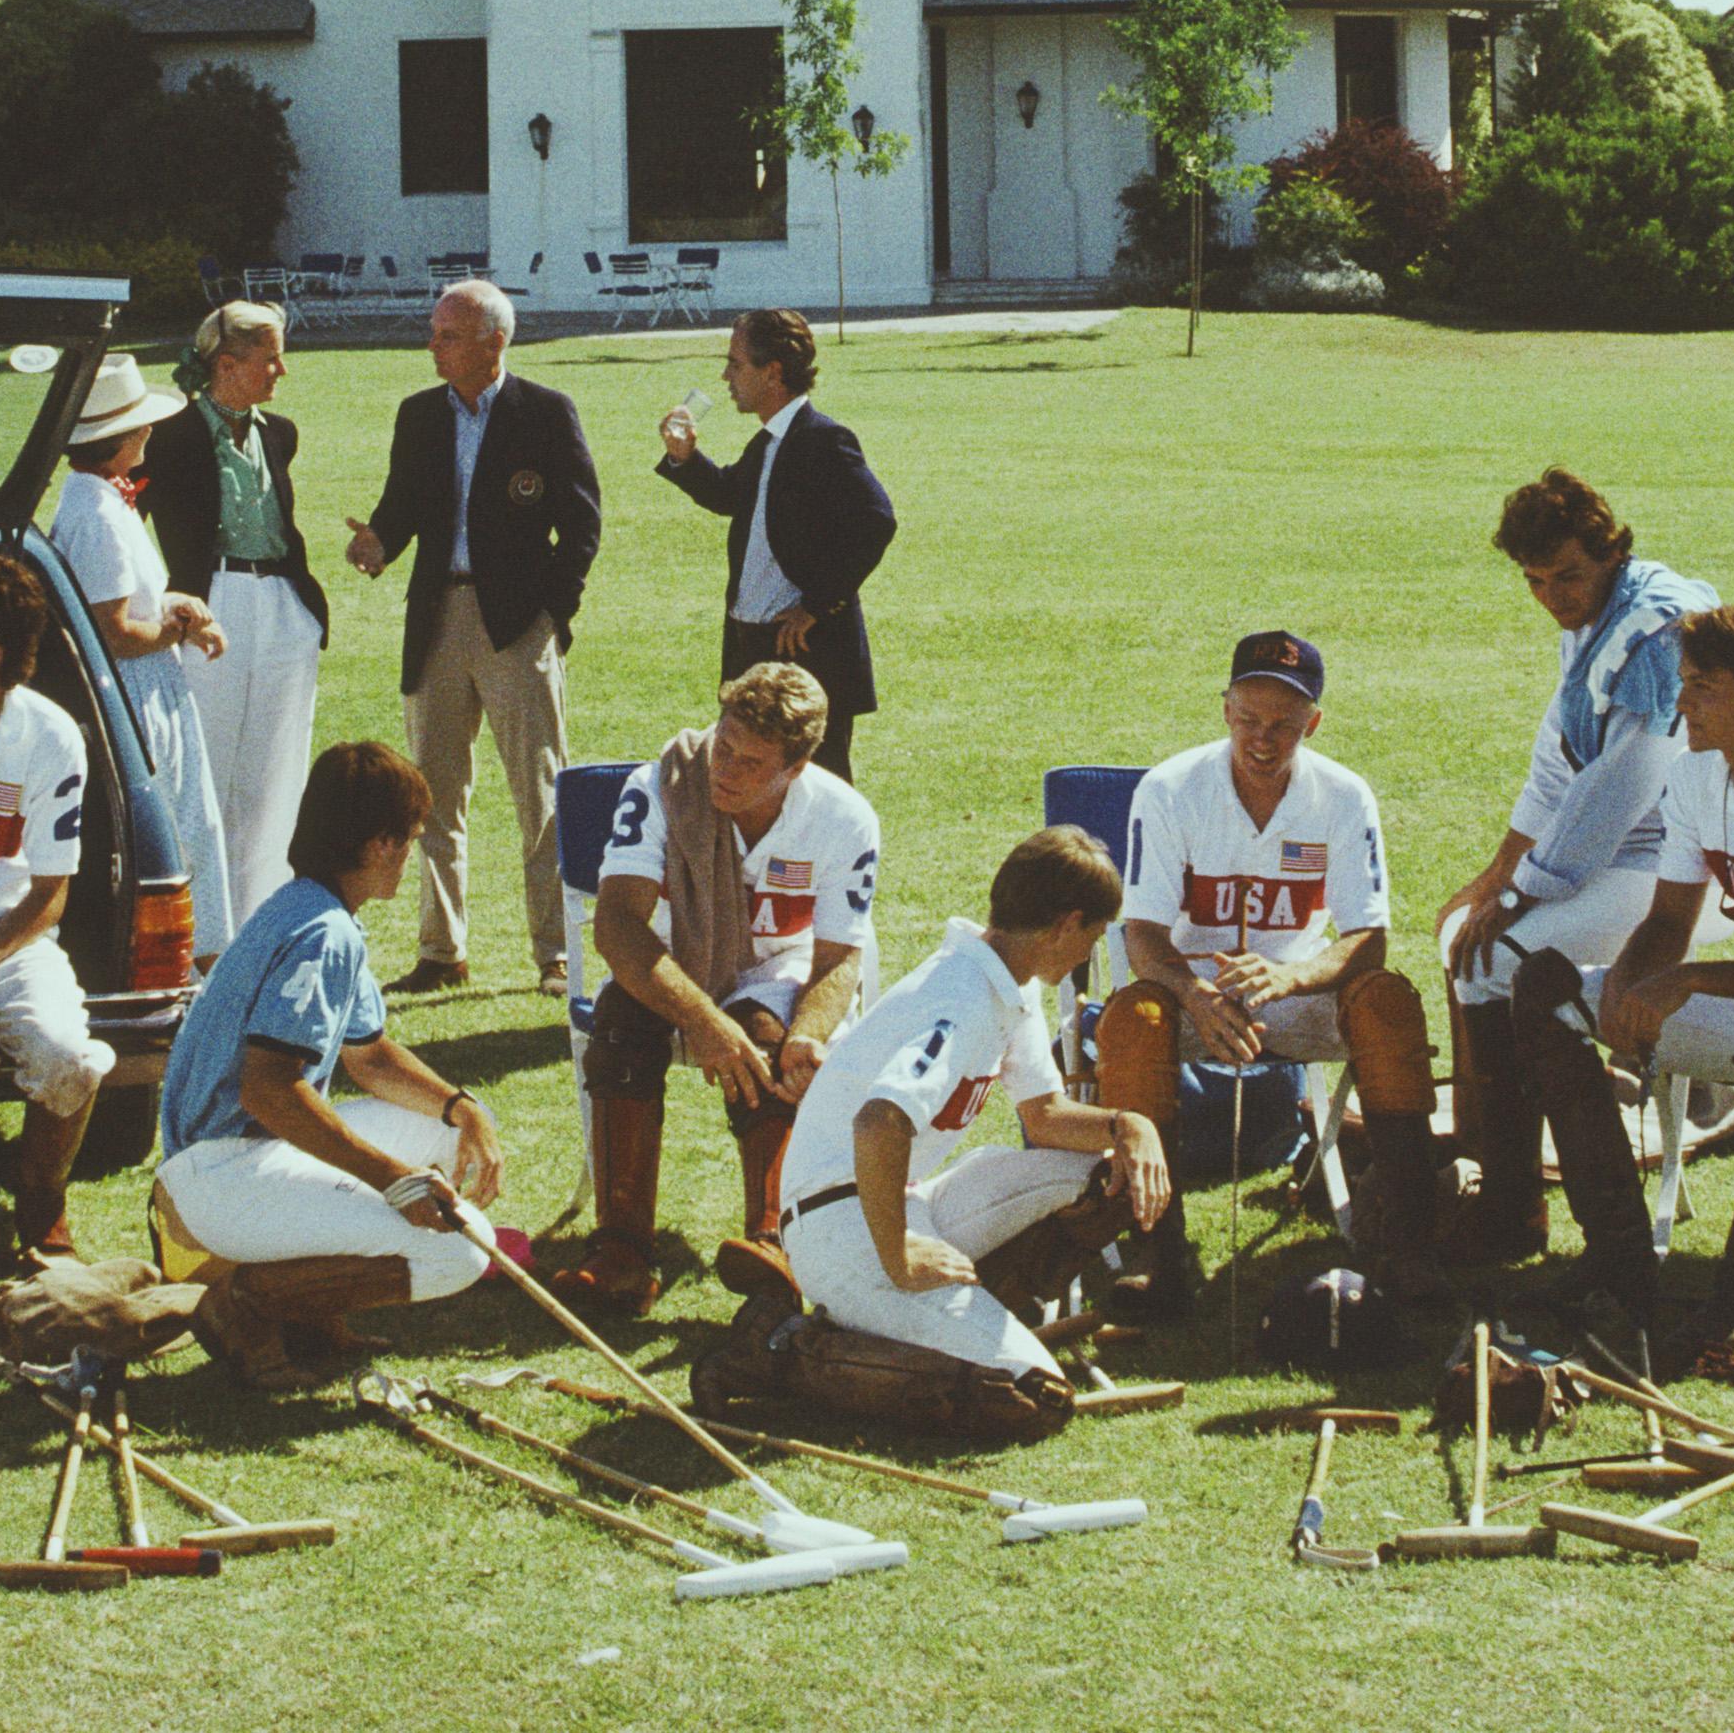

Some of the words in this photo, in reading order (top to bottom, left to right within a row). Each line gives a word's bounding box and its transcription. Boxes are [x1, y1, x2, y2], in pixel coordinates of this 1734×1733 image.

[611, 787, 650, 848] 3
[1214, 880, 1298, 927] USA
[279, 958, 323, 1014] 4
